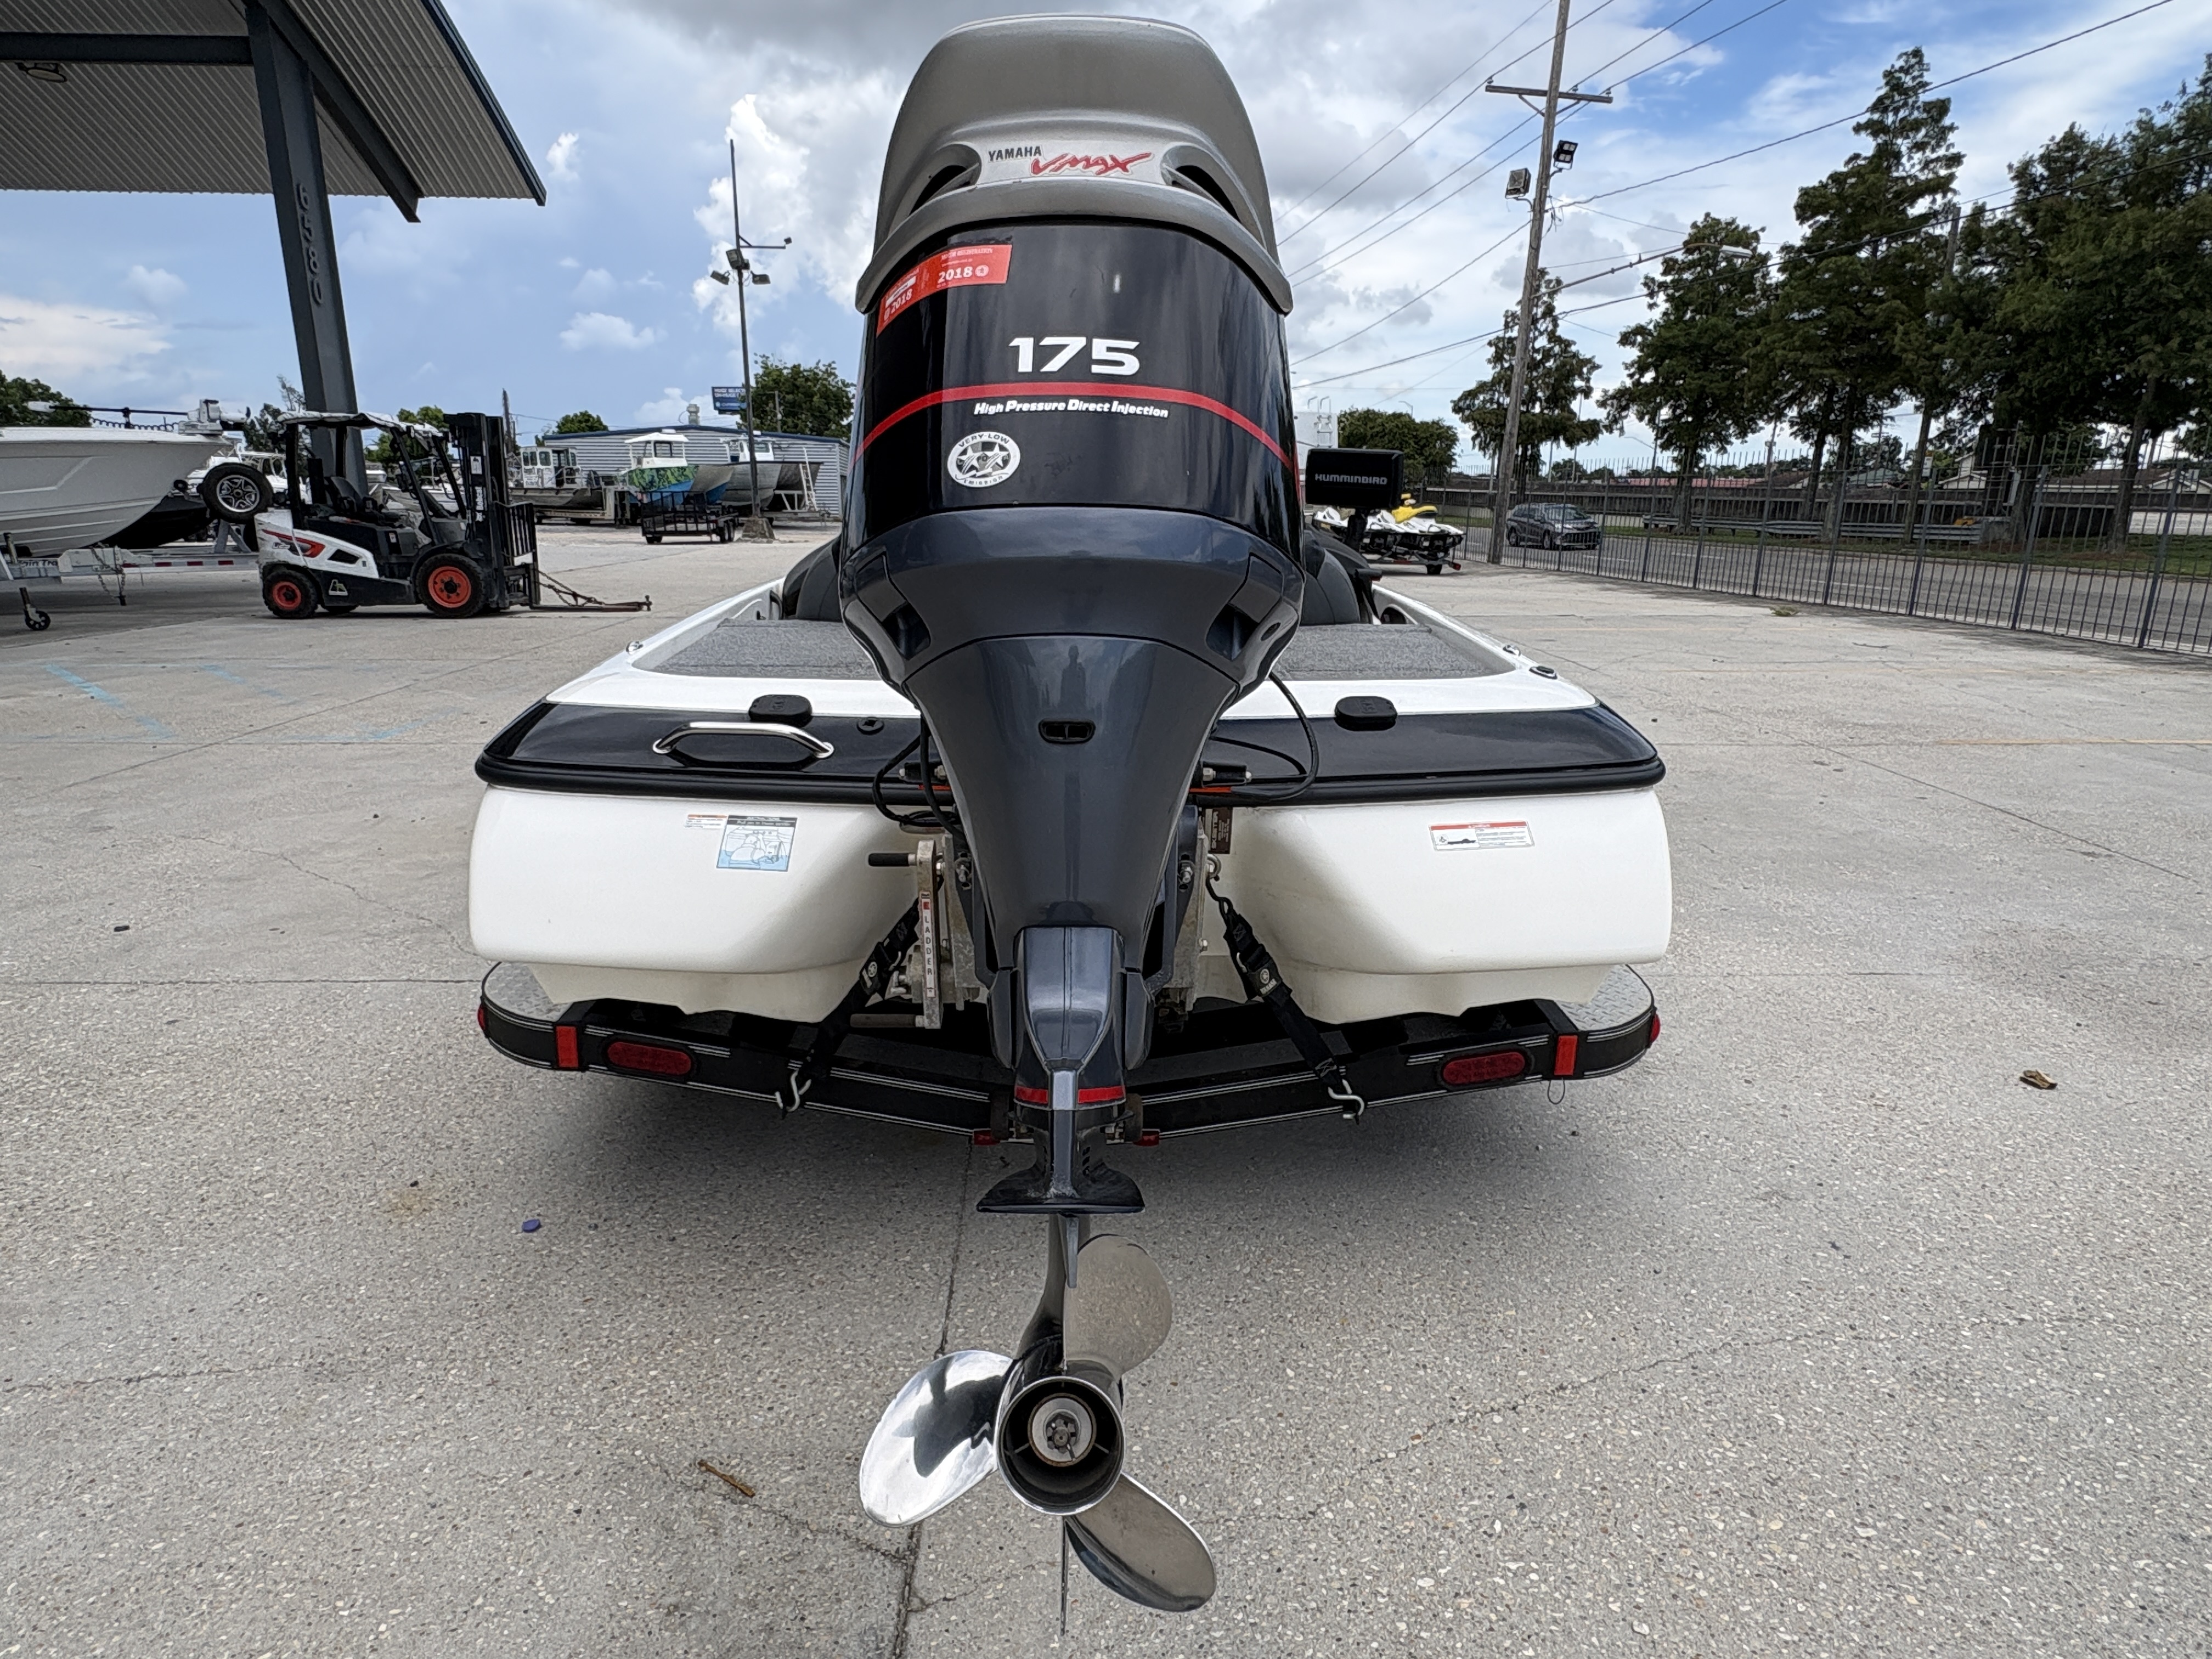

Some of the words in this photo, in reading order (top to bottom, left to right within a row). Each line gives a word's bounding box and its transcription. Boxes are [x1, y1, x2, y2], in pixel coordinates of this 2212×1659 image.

[989, 146, 1041, 161] YAMAHA
[938, 266, 973, 284] 2018
[1009, 337, 1140, 375] 175
[973, 403, 1003, 415] High
[1005, 400, 1065, 412] Pressure
[1067, 399, 1110, 412] Direct
[1111, 401, 1169, 418] Injection
[1314, 473, 1387, 485] HUMMINBIRD
